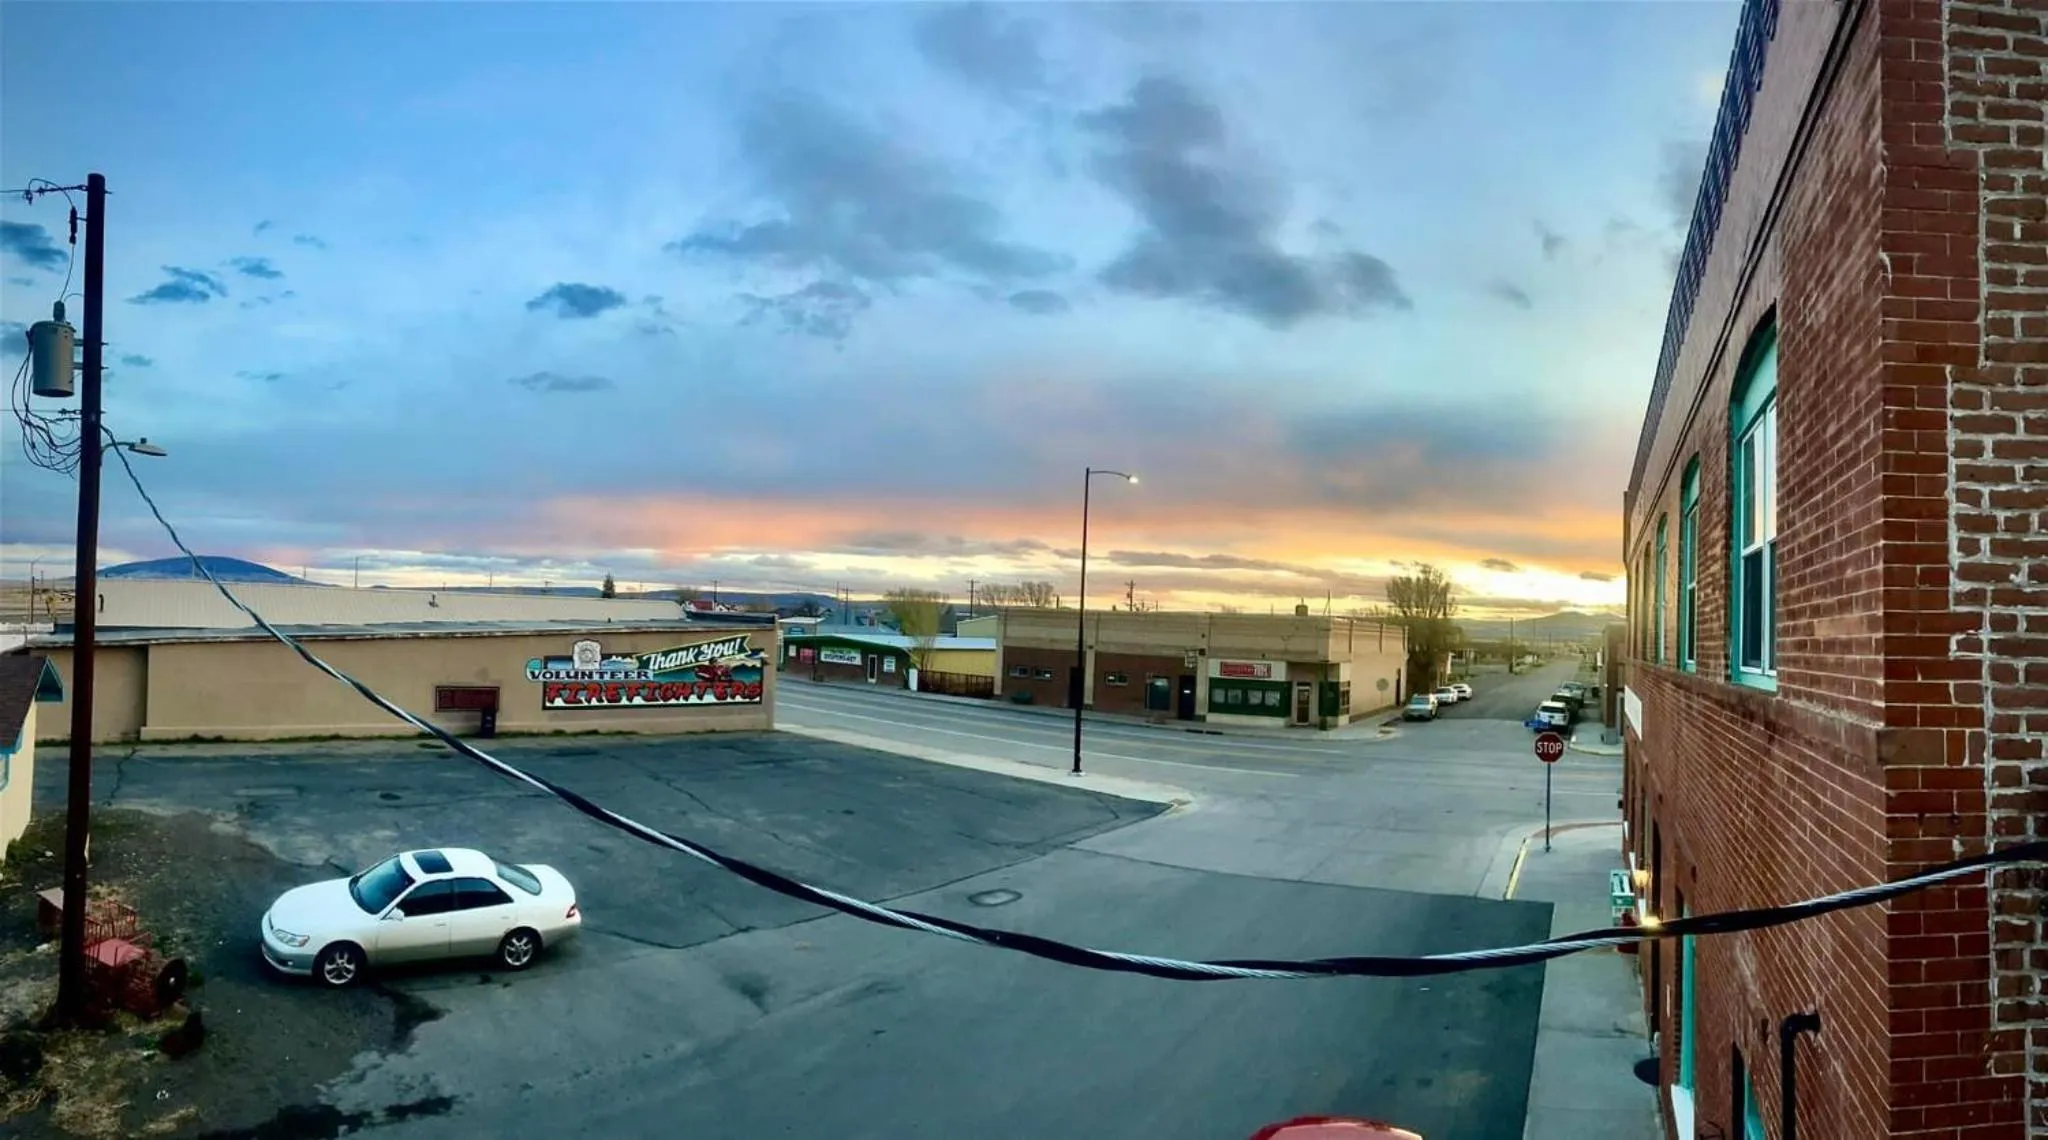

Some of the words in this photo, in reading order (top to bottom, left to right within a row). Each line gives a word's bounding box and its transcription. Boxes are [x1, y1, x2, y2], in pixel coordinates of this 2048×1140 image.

[644, 649, 699, 670] Thank
[699, 639, 741, 663] You!
[530, 669, 649, 681] VOLUNTEER
[546, 682, 761, 704] FIREFIGHTERS
[1537, 742, 1562, 754] STOP
